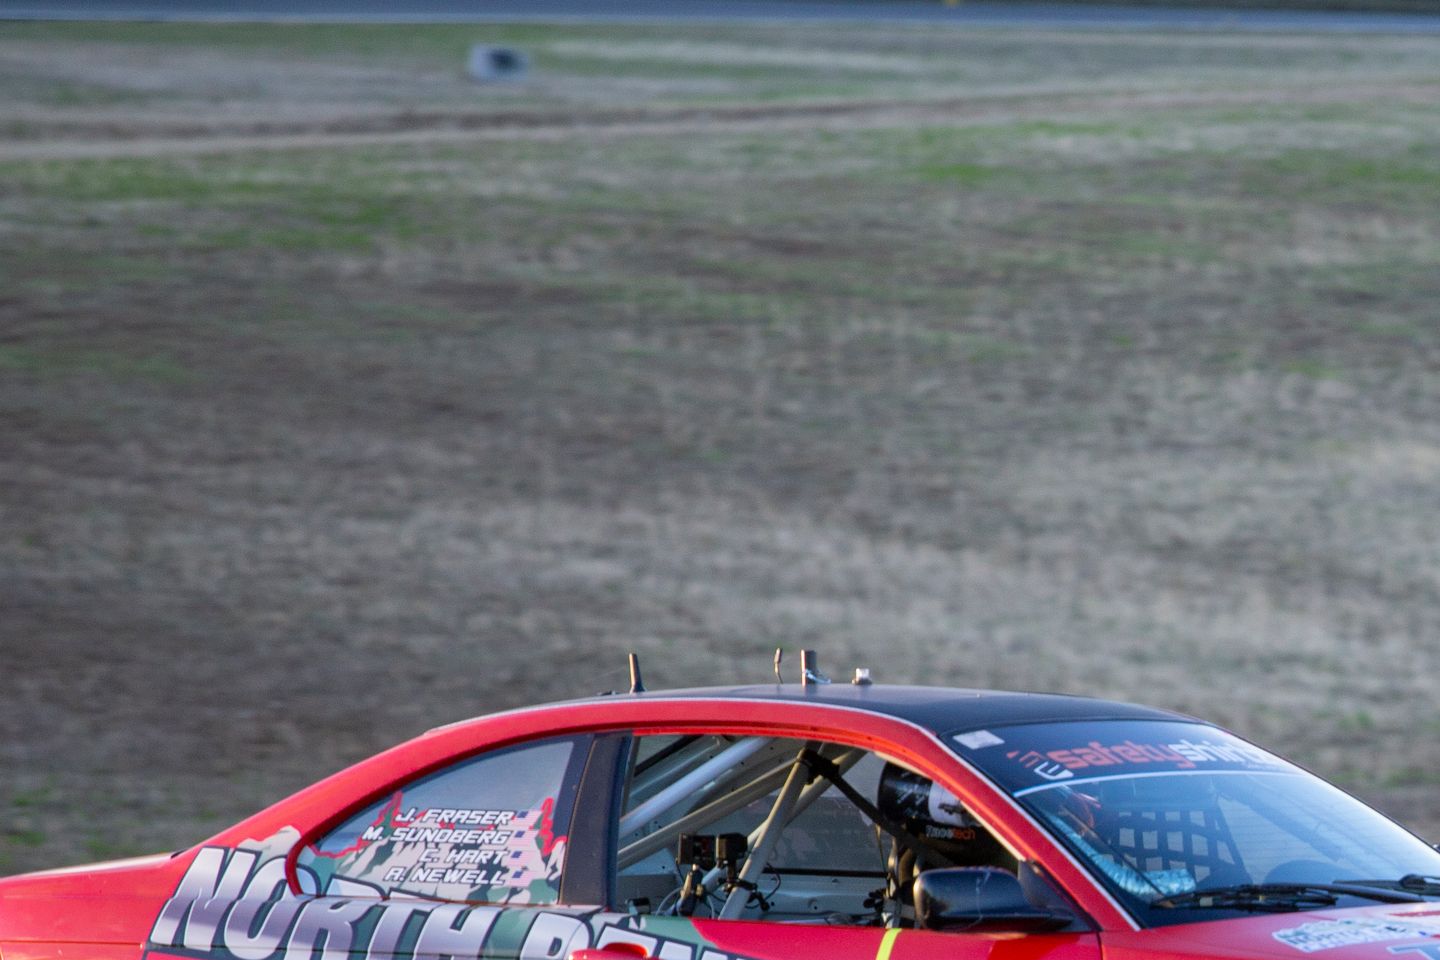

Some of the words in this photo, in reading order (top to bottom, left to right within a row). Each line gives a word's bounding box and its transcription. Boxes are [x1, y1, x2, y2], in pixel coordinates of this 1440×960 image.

[396, 808, 415, 822] J.
[422, 808, 515, 825] FRASER
[362, 827, 383, 841] M.
[390, 828, 512, 845] SUNDBERG
[420, 849, 439, 863] C.
[444, 849, 509, 865] HART
[410, 868, 506, 885] NEWELL
